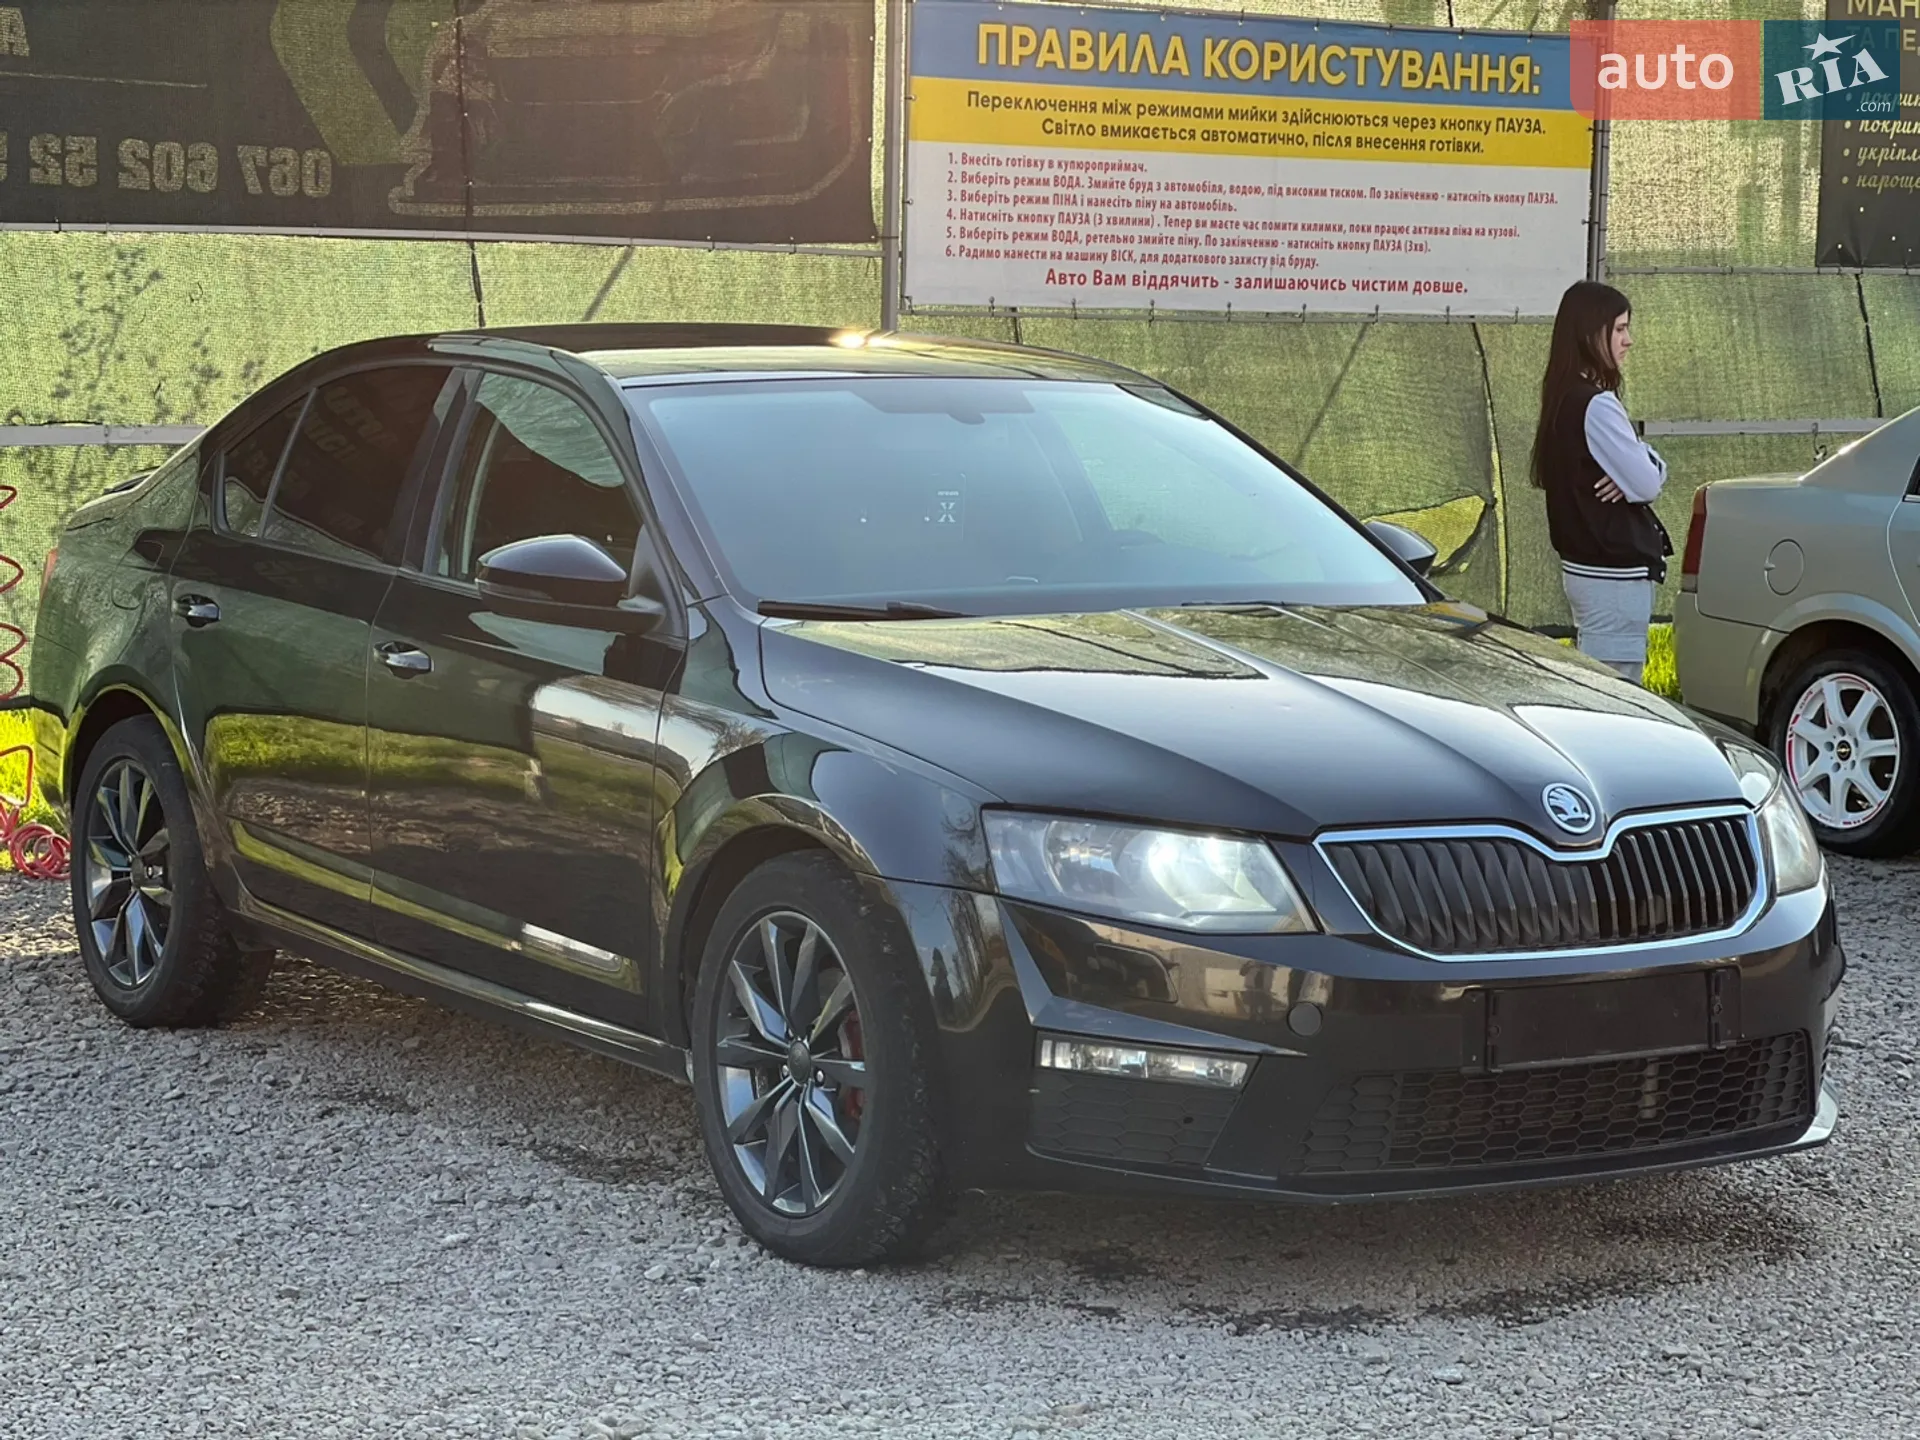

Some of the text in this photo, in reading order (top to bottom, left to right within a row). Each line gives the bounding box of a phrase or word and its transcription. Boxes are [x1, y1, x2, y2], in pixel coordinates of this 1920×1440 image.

[978, 22, 1540, 94] ПРАВИЛА КОРИСТУВАННЯ:
[967, 90, 1546, 135] Переключення між режимами мийки здійснюються через кнопку ПАУЗА.
[1041, 118, 1484, 152] Світло вмикається автоматично, після внесення готівки.
[948, 151, 958, 164] 1.
[960, 152, 1003, 166] Внесіть
[1005, 155, 1045, 171] готівку
[1056, 159, 1147, 173] купюроприймач.
[946, 188, 957, 201] 3.
[960, 189, 1010, 205] Виберіть
[1012, 194, 1050, 206] режим
[1052, 192, 1078, 206] ПІНА
[1086, 195, 1132, 208] нанесіть
[1134, 196, 1157, 211] піну
[1159, 199, 1172, 209] на
[1174, 198, 1237, 211] автомобіль.
[947, 170, 957, 183] 2.
[960, 170, 1011, 187] Виберіть
[1013, 176, 1050, 188] режим
[1052, 174, 1085, 189] ВОДА.
[1087, 176, 1126, 189] Змийте
[1128, 177, 1153, 193] бруд
[1163, 180, 1226, 194] автомобіля,
[1228, 184, 1265, 196] водою,
[1266, 183, 1283, 197] під
[1285, 186, 1327, 197] високим
[1329, 188, 1367, 198] тиском.
[1368, 186, 1382, 199] По
[1383, 188, 1439, 200] закінченню
[1446, 190, 1492, 202] натисніть
[1493, 193, 1525, 206] кнопку
[1526, 191, 1558, 204] ПАУЗА.
[946, 207, 956, 220] 4.
[959, 208, 1014, 222] Натисніть
[1016, 213, 1055, 226] кнопку
[1057, 211, 1090, 225] ПАУЗА
[1092, 212, 1103, 226] (3
[1105, 214, 1155, 228] хвилини)
[1163, 214, 1192, 231] Тепер
[1194, 218, 1207, 228] ви
[1209, 219, 1240, 229] маєте
[1242, 220, 1259, 230] час
[1261, 220, 1298, 231] помити
[1300, 222, 1346, 234] килимки,
[1348, 223, 1372, 233] поки
[1373, 224, 1410, 236] працює
[1411, 225, 1450, 235] активна
[1451, 224, 1472, 236] піна
[1474, 227, 1486, 236] на
[1487, 225, 1520, 239] кузові.
[946, 226, 956, 238] 5.
[959, 226, 1009, 242] Виберіть
[1011, 231, 1048, 243] режим
[1051, 229, 1083, 244] ВОДА,
[1085, 233, 1135, 246] ретельно
[1137, 232, 1175, 245] змийте
[1177, 233, 1202, 248] піну.
[1204, 233, 1218, 246] По
[1219, 235, 1279, 247] закінченню
[1286, 237, 1335, 249] натисніть
[1336, 240, 1371, 253] кнопку
[1372, 238, 1402, 251] ПАУЗА
[1403, 239, 1431, 253] (3хв).
[945, 244, 1319, 270] 6. Радимо нанести на машину ВІСК, для додаткового захисту від бруду.
[1044, 268, 1087, 285] Авто
[1092, 269, 1126, 286] Вам
[1131, 270, 1219, 290] віддячить
[1233, 276, 1347, 290] залишаючись
[1351, 279, 1408, 291] чистим
[1411, 280, 1468, 295] довше.
